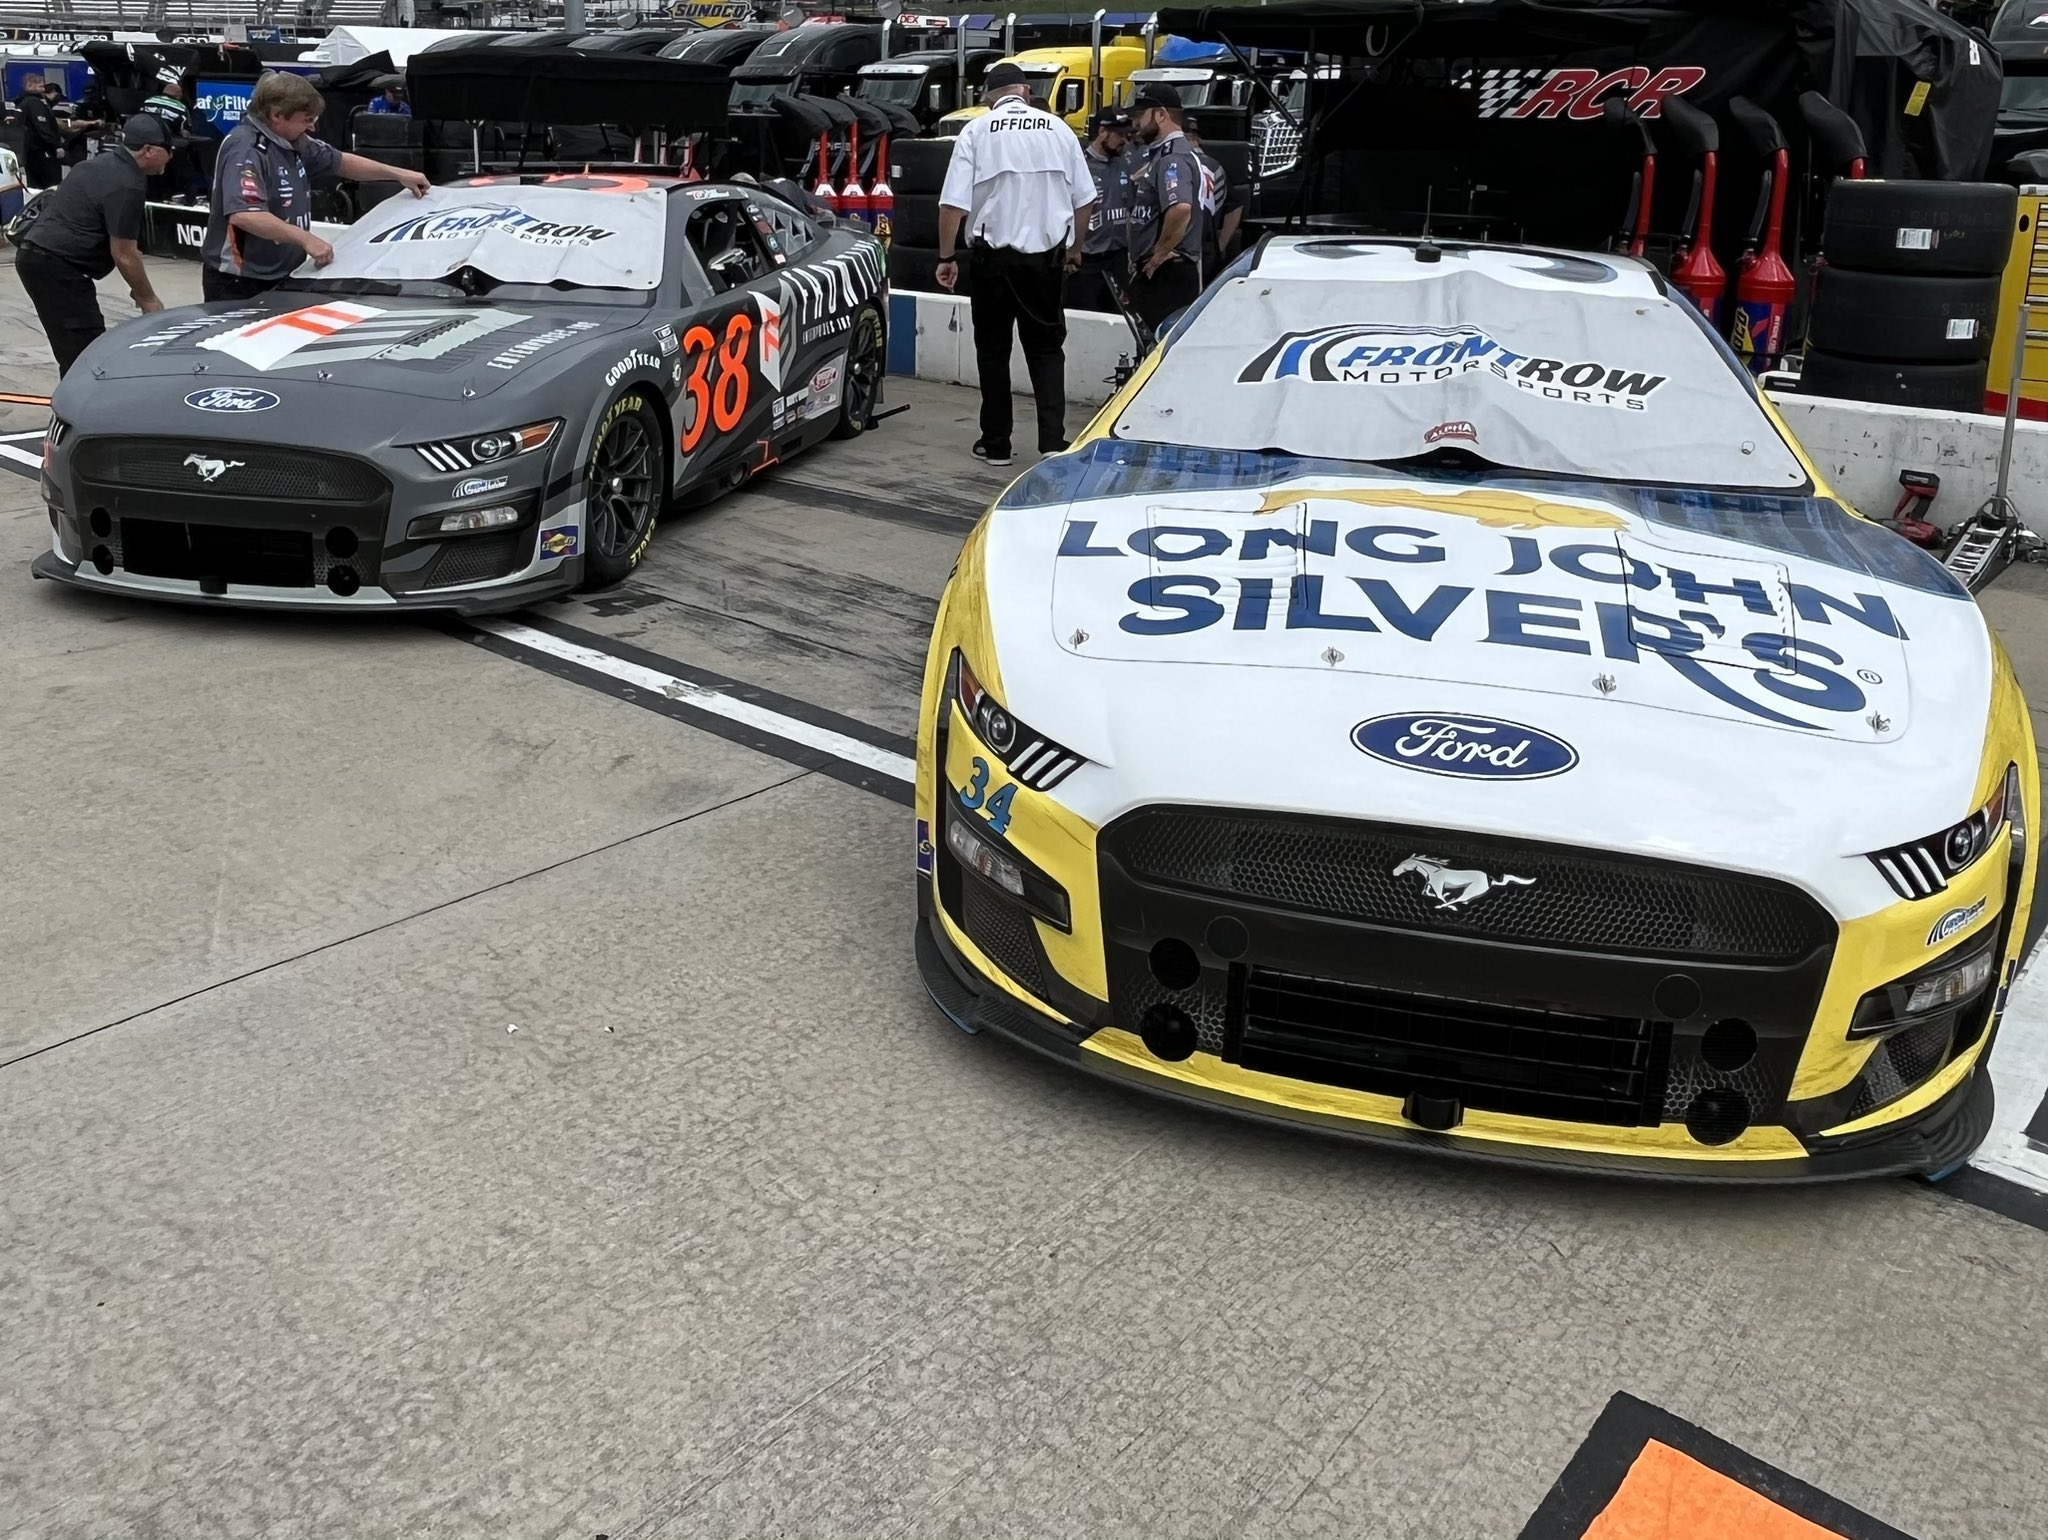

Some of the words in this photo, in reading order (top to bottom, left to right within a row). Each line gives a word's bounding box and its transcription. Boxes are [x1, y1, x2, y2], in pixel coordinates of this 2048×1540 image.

[674, 4, 745, 17] SUNOCO
[1511, 66, 1706, 119] RCR
[990, 118, 1054, 133] OFFICIAL
[605, 347, 660, 387] GOODYEAR
[681, 311, 753, 454] 38
[1342, 359, 1646, 411] MOTORSPORTS
[197, 388, 265, 410] Ford
[1056, 519, 1447, 563] LONG
[1494, 534, 1911, 642] JOHN
[1118, 573, 1868, 731] SILVER'S
[1395, 718, 1531, 768] Ford
[959, 755, 1019, 835] 34
